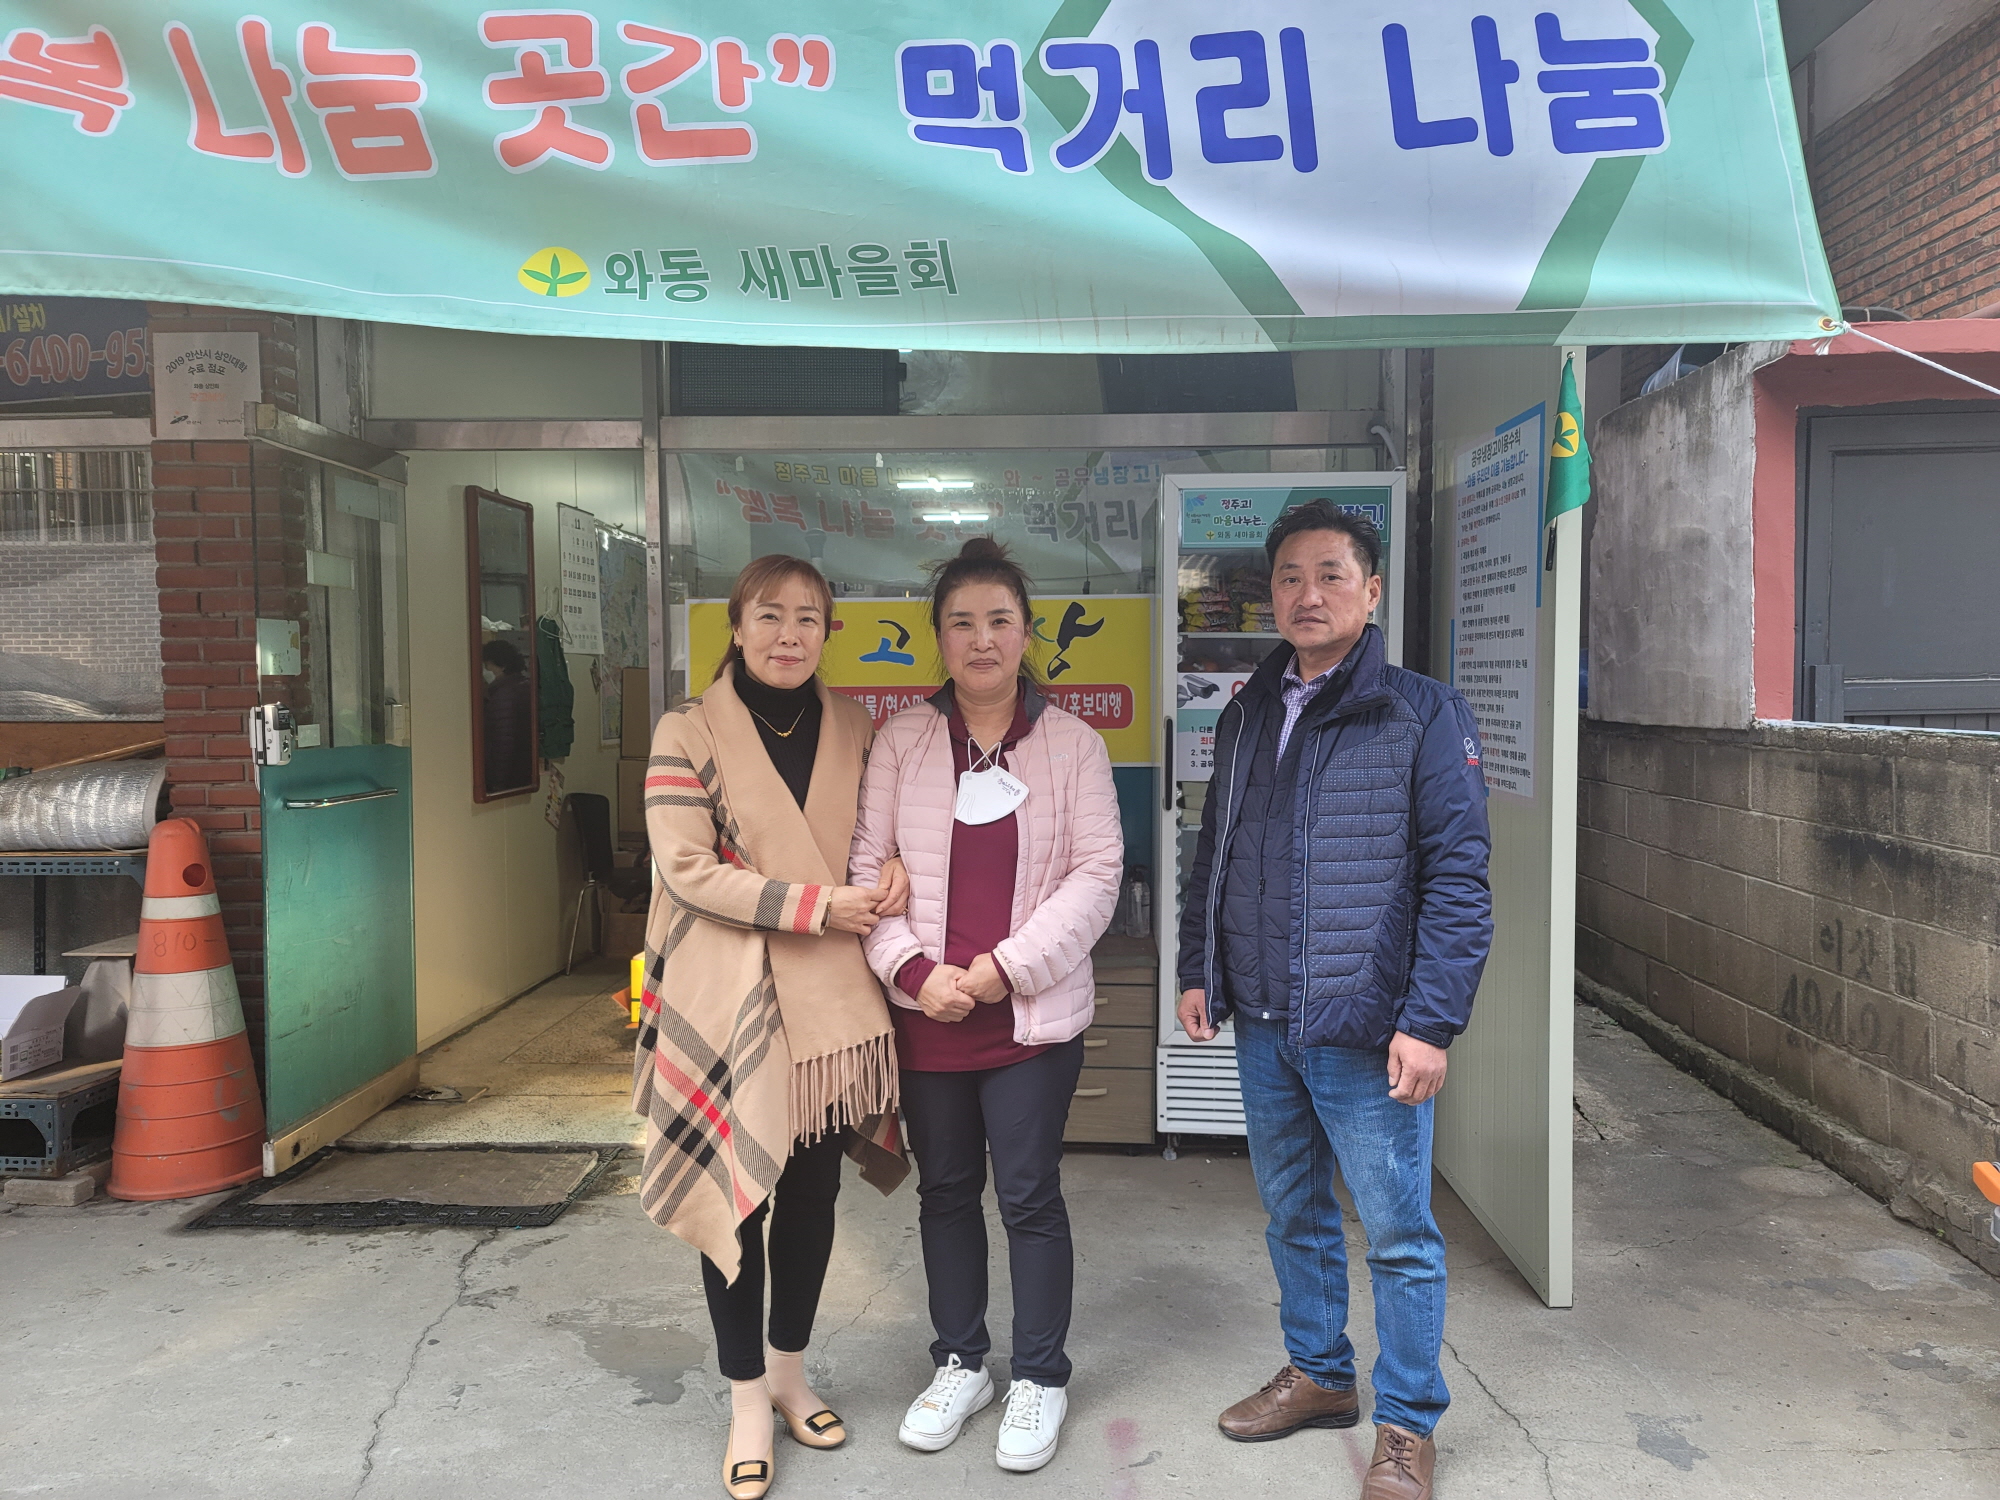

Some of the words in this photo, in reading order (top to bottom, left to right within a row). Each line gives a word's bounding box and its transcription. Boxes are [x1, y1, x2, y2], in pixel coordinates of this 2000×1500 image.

[163, 15, 437, 181] 나눔
[478, 10, 838, 172] 곳간”
[895, 27, 1322, 186] 먹거리
[1381, 12, 1671, 157] 나눔
[602, 249, 711, 303] 와동
[737, 238, 959, 302] 새마을회
[0, 328, 152, 386] -6400-95
[165, 356, 185, 374] 2019
[185, 349, 212, 361] 안산시
[214, 350, 248, 373] 상인대학
[188, 363, 205, 375] 수료
[207, 363, 226, 376] 점포
[838, 466, 879, 487] 마음
[575, 518, 581, 529] 11
[1022, 500, 1140, 543] 먹거리
